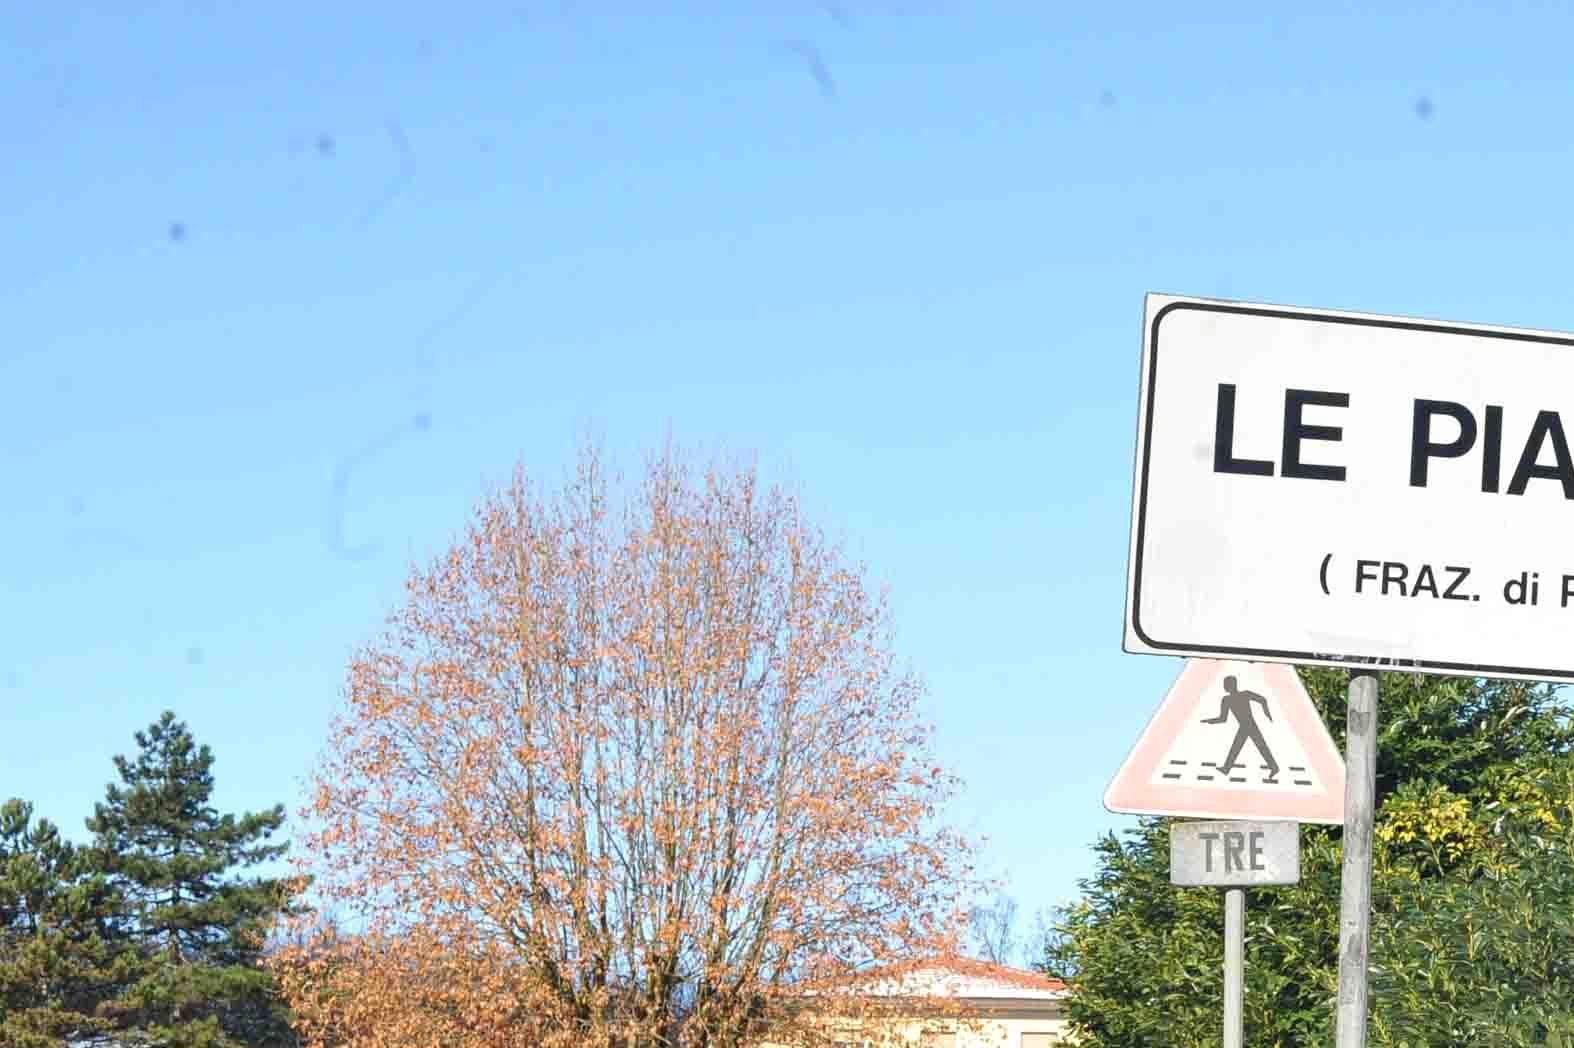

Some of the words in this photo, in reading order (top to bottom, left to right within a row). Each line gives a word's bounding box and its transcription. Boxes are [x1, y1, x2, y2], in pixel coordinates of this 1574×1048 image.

[1213, 383, 1350, 482] LE
[1355, 559, 1481, 602] FRAZ.
[1503, 570, 1539, 608] di
[1199, 831, 1265, 874] TRE
